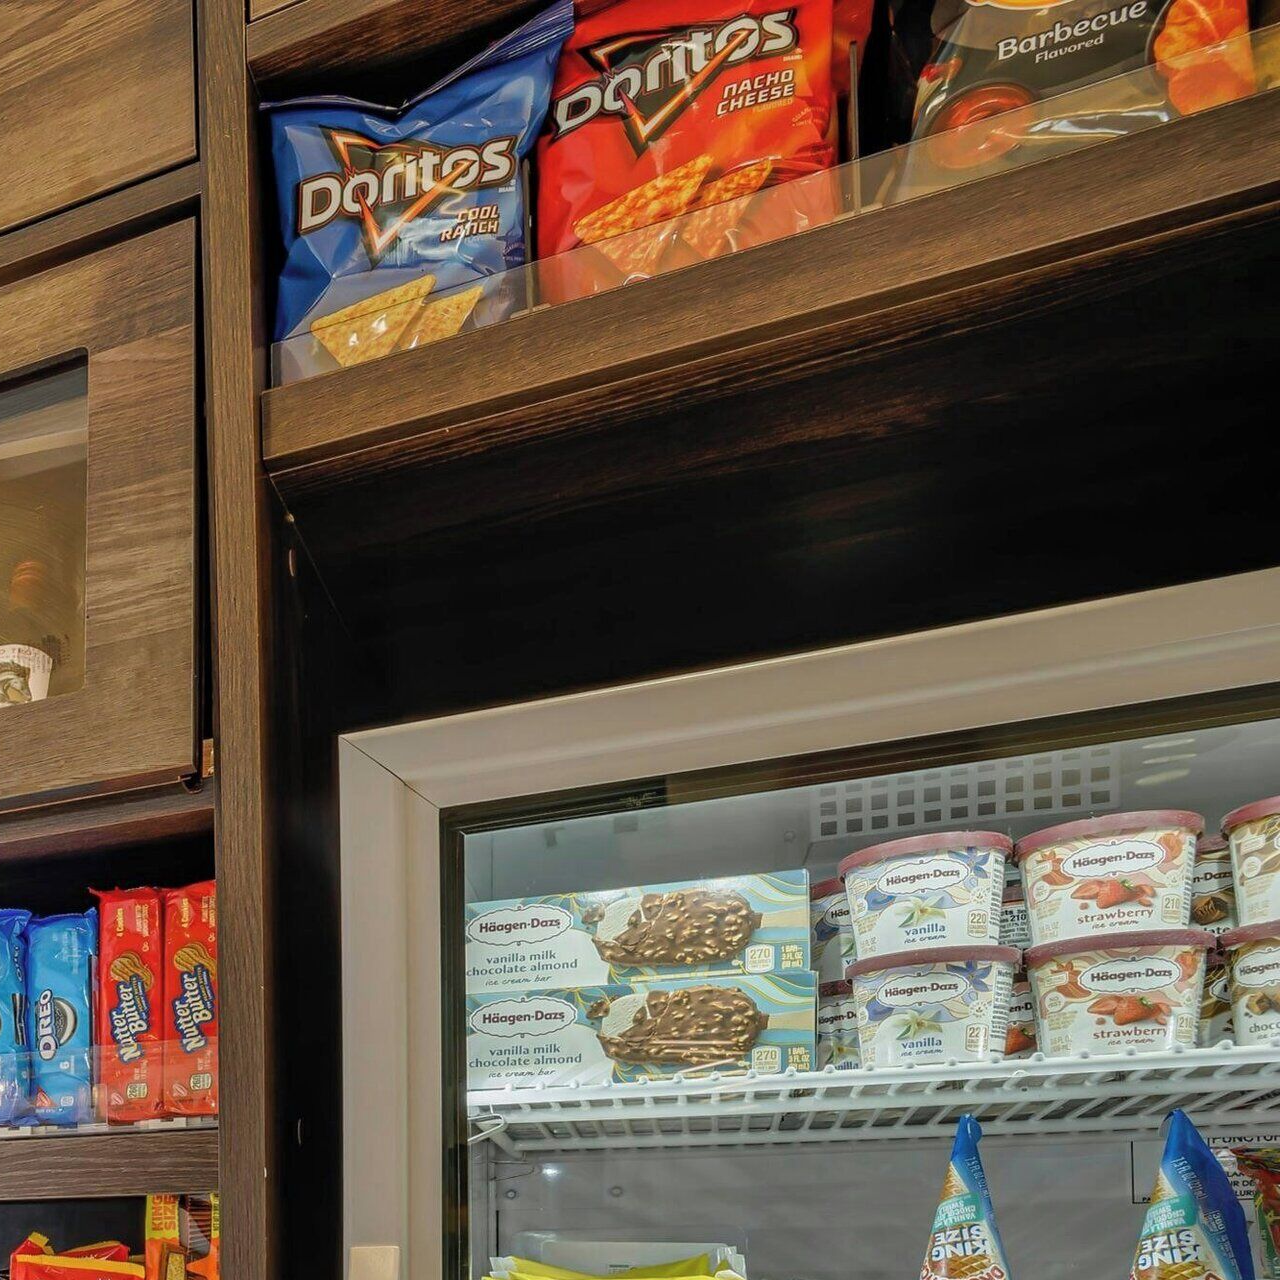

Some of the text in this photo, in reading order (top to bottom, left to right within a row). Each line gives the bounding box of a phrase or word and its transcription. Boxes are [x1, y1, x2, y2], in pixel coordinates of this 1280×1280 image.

[997, 0, 1147, 62] Barbecue
[1035, 33, 1105, 64] Flavored
[555, 11, 796, 139] Doritos
[722, 68, 794, 97] NACHO
[717, 84, 795, 116] CHEESE
[300, 137, 518, 233] Doritos
[457, 205, 501, 222] COOL
[440, 219, 501, 241] RANCH
[1072, 848, 1155, 869] Häagen-Dazs
[885, 867, 961, 888] Häagen-Dazs
[479, 916, 561, 933] Häagen-Dazs
[970, 913, 987, 926] 220
[1077, 907, 1154, 925] strawberry
[904, 923, 946, 937] vanilla
[486, 951, 556, 965] vanilla milk
[750, 948, 771, 960] 270
[466, 960, 578, 977] chocolate almond
[1090, 966, 1174, 983] Häagen-Dazs
[184, 974, 212, 1023] Butter
[884, 980, 959, 1000] Häagen-Dazs
[119, 982, 148, 1034] Butter
[482, 1009, 566, 1026] Häagen-Dazs
[39, 989, 56, 1061] OREO
[175, 1000, 205, 1051] Nutter
[1092, 1026, 1168, 1040] strawberry
[113, 1011, 141, 1062] Nutter
[901, 1038, 942, 1050] vanilla
[469, 1053, 582, 1068] chocolate almond
[490, 1044, 560, 1057] vanilla milk
[756, 1049, 777, 1061] 270
[152, 1194, 164, 1232] KING
[164, 1195, 176, 1231] SIZE
[934, 1225, 981, 1245] SIZE
[1141, 1230, 1193, 1252] SIZE
[931, 1239, 989, 1260] KING
[1138, 1245, 1199, 1270] KING
